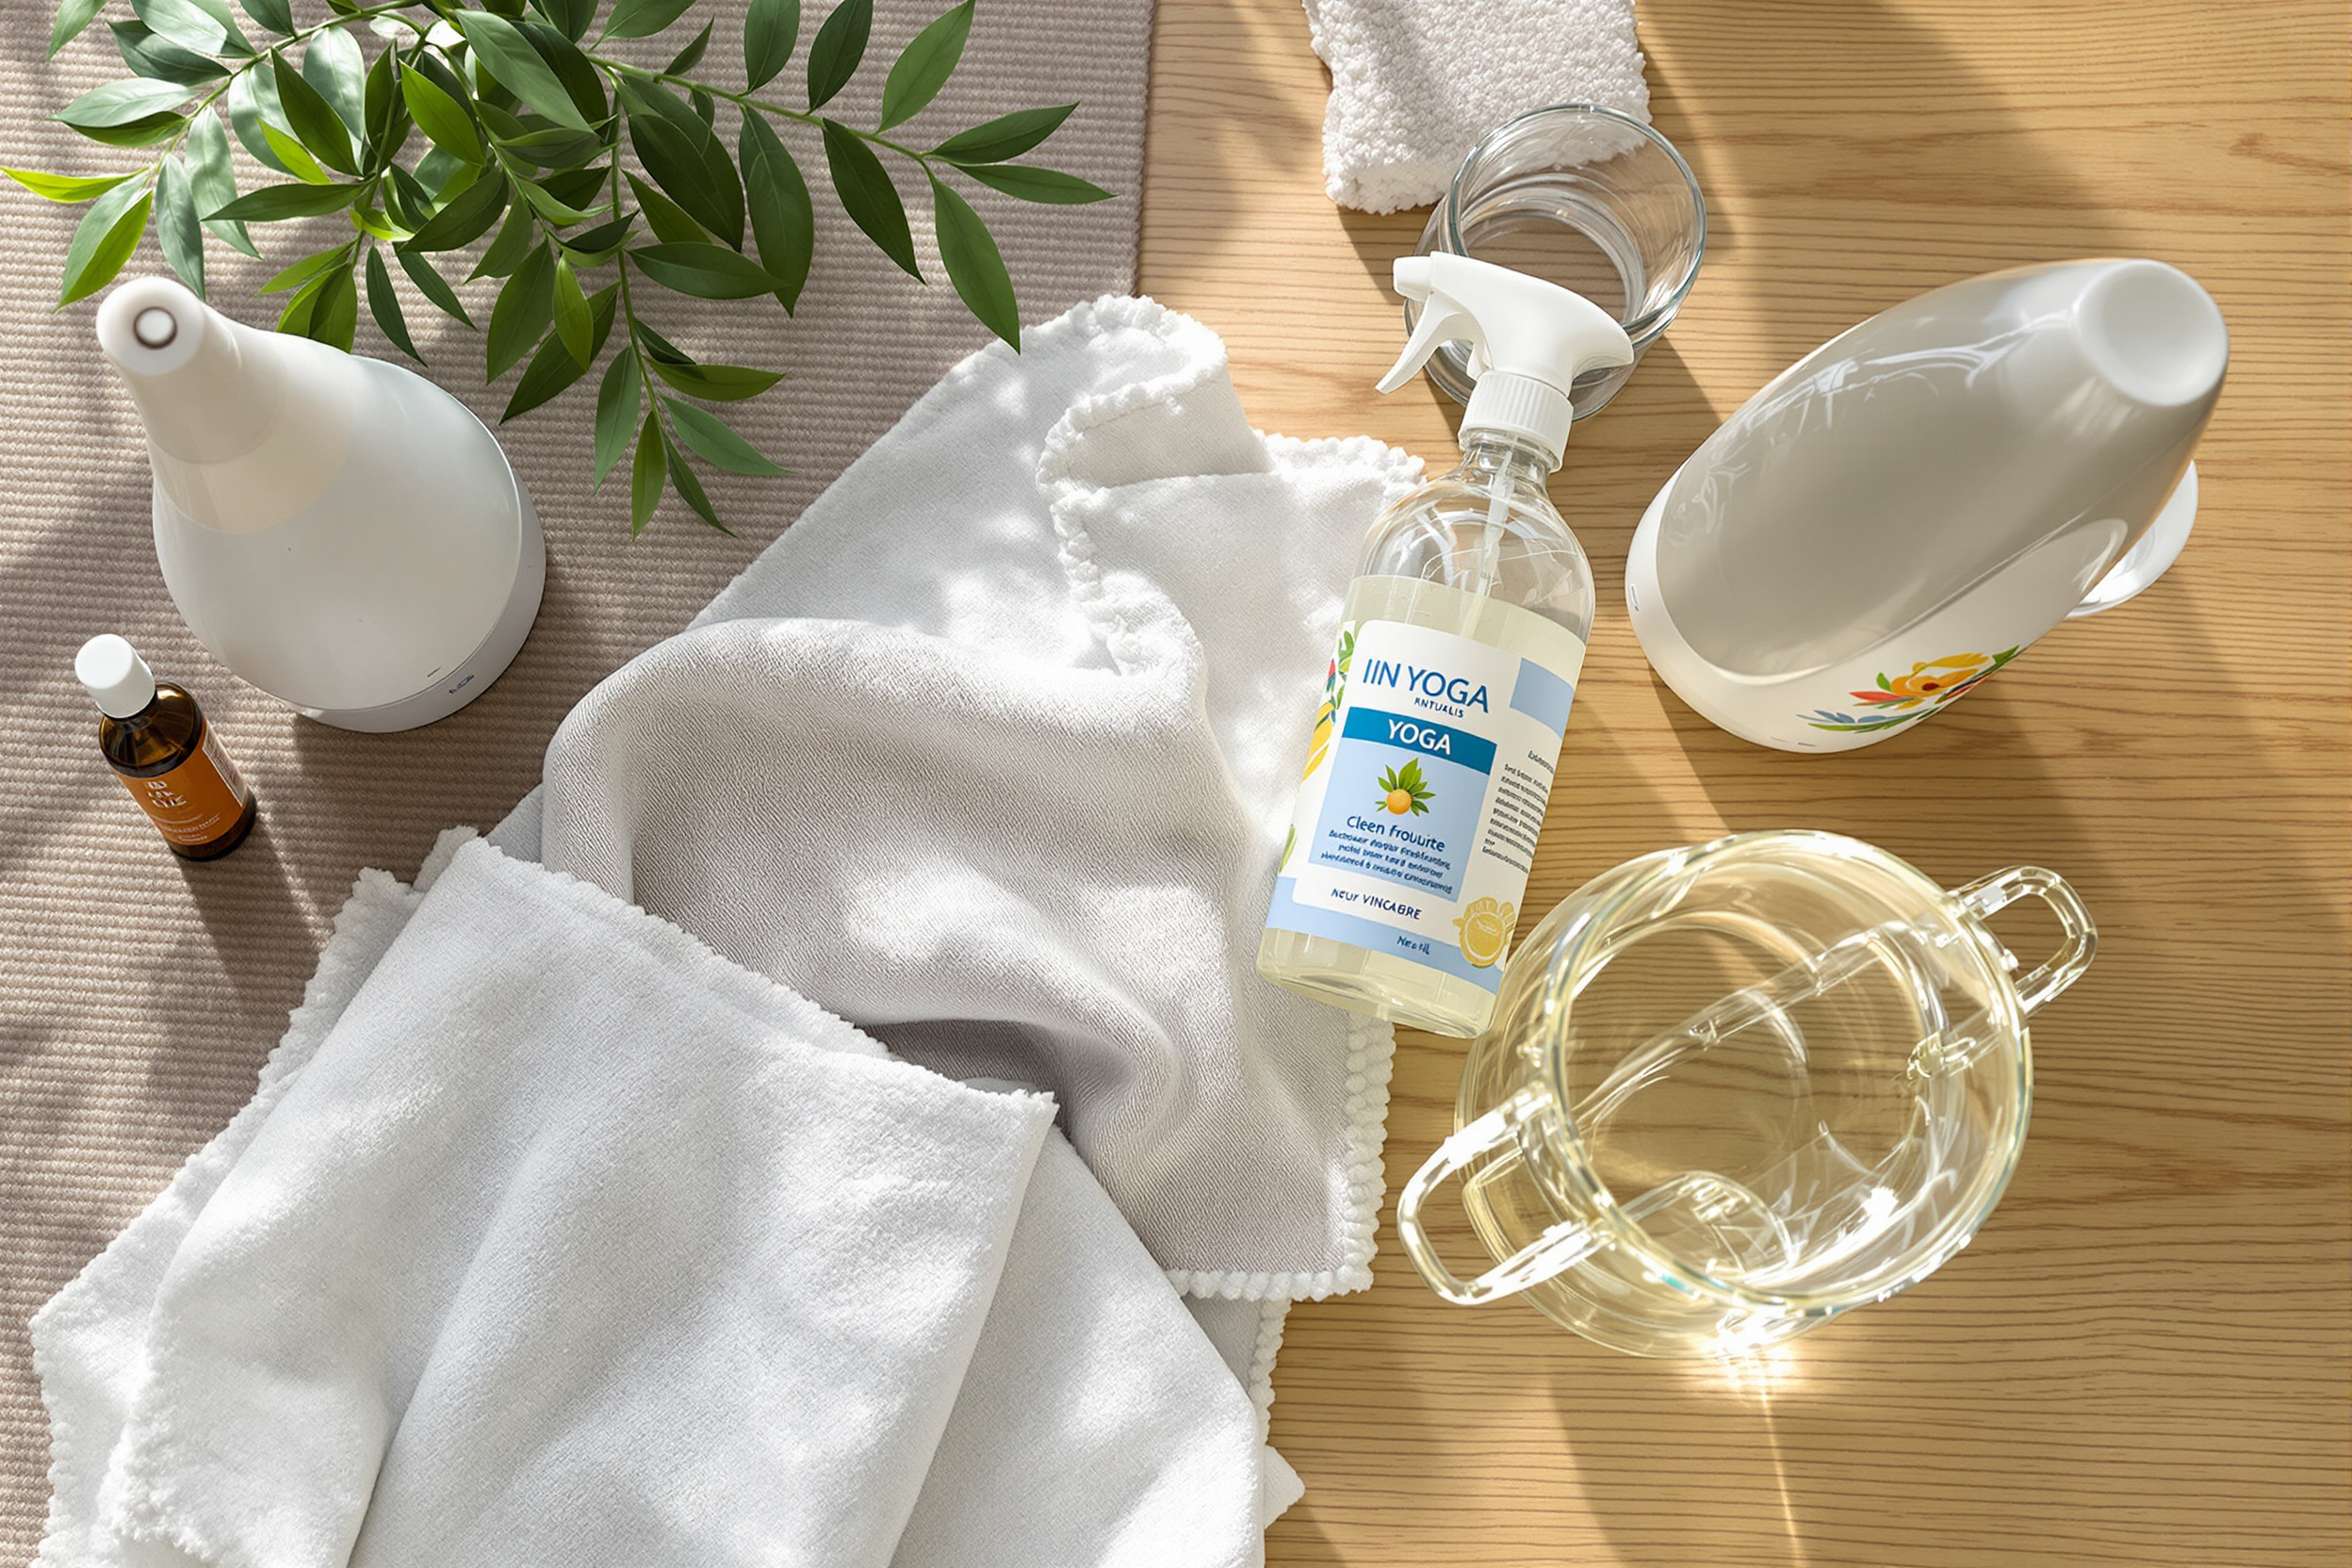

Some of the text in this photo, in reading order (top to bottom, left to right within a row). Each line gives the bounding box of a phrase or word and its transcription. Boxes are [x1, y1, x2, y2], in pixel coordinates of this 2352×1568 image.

[1408, 665, 1489, 713] YOGA
[1388, 718, 1451, 756] YOGA
[1347, 815, 1385, 836] Cleen
